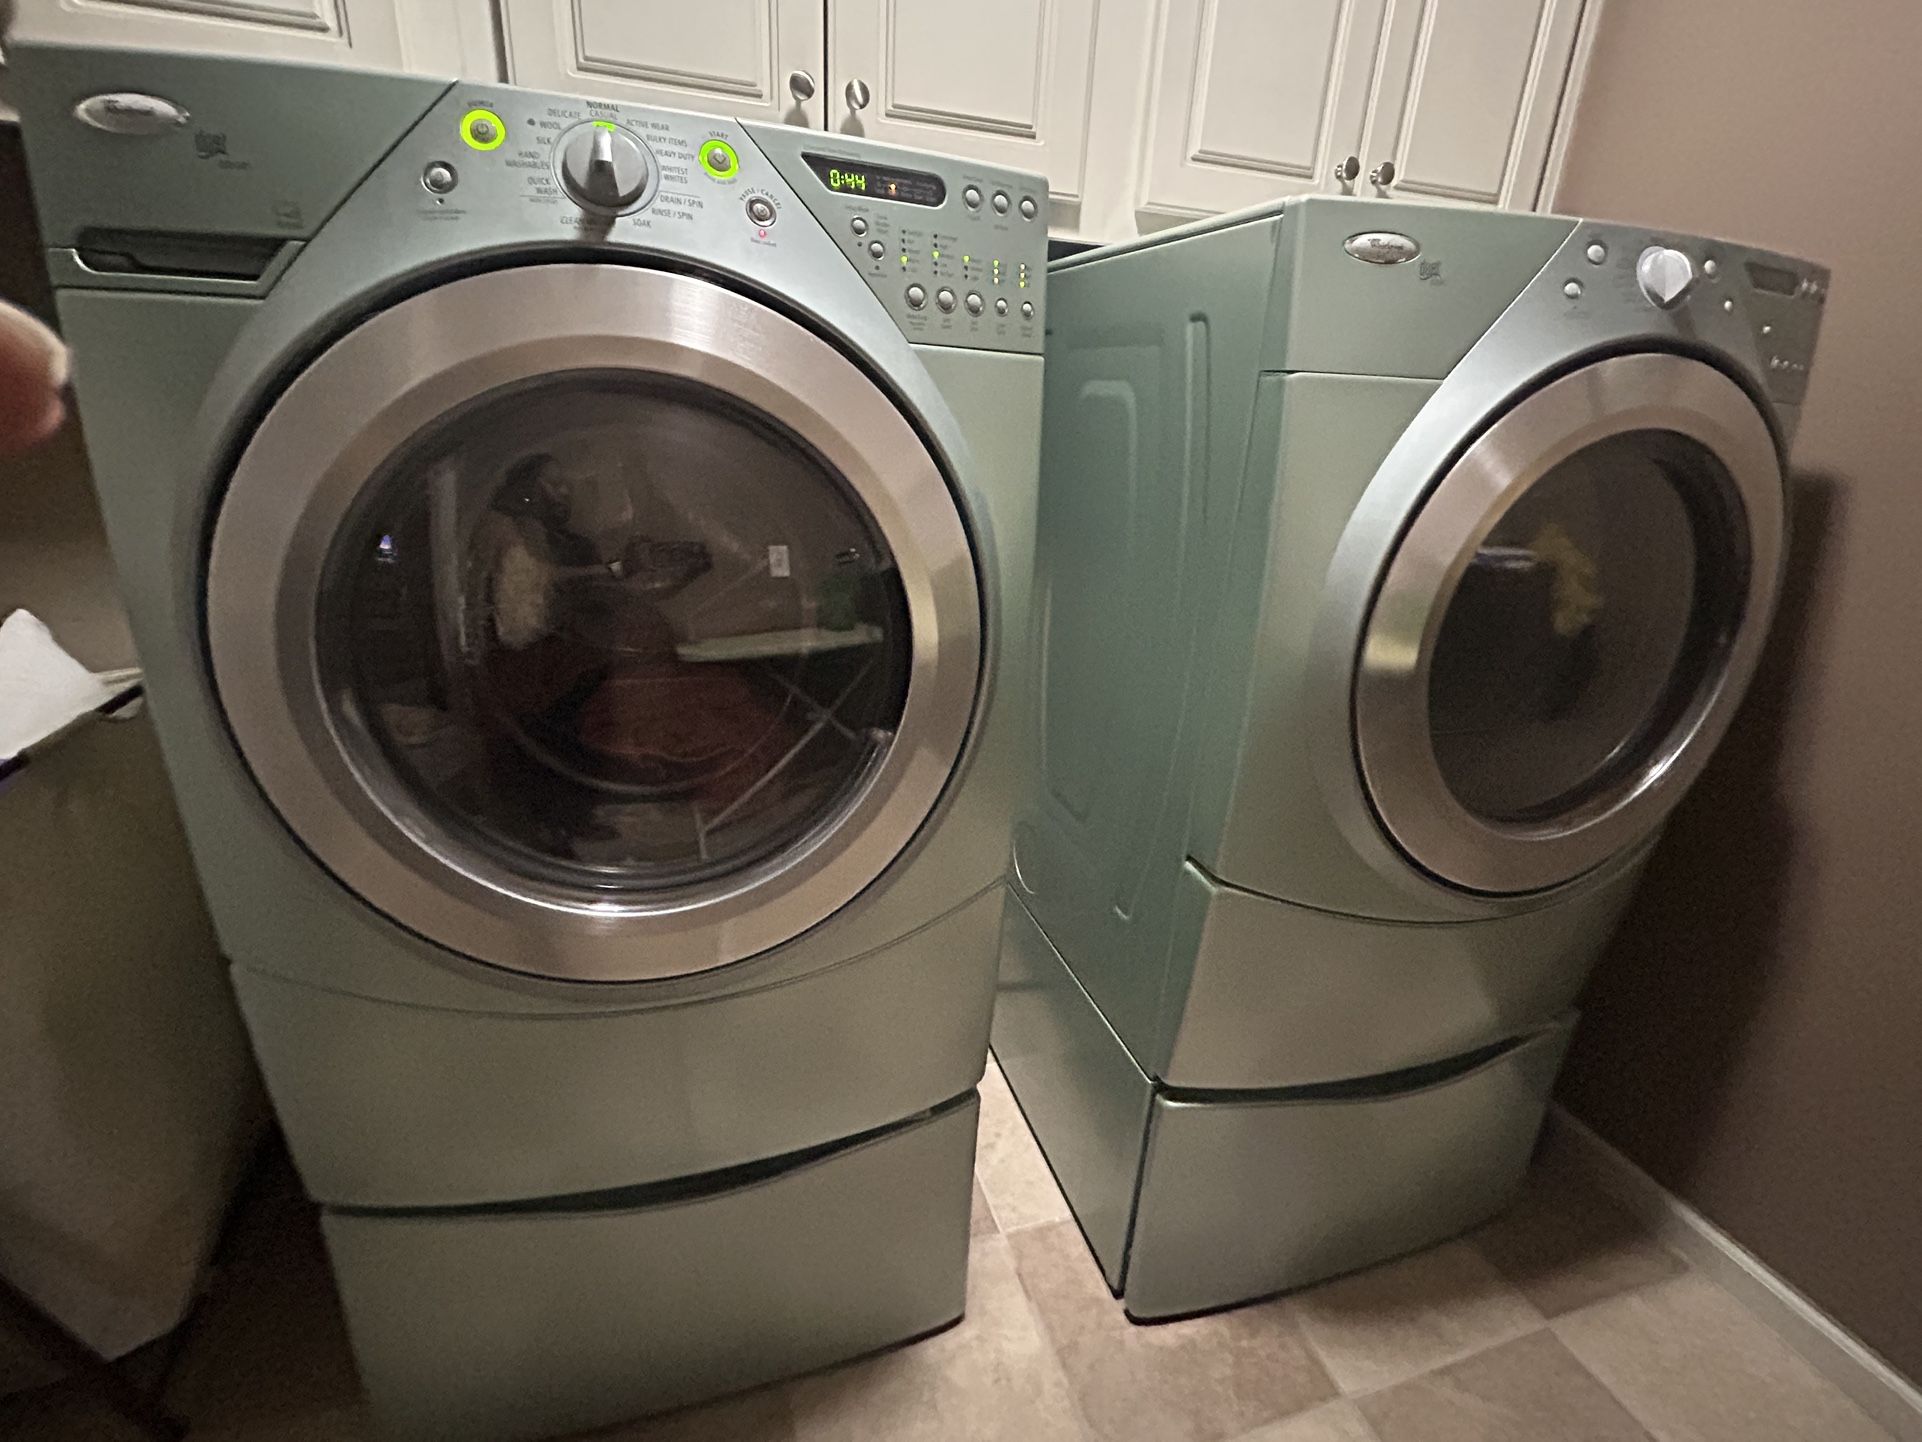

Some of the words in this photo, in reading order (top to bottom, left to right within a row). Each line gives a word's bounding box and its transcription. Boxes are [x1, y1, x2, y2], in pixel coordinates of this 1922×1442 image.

[586, 101, 620, 112] NORMAL
[547, 108, 581, 119] DELICATE
[589, 110, 618, 121] CASUAL
[540, 121, 561, 130] WOOL
[626, 119, 649, 129] ACTIVE
[651, 123, 670, 131] WEAR
[536, 136, 552, 145] SILK
[646, 134, 666, 144] BULKY
[668, 136, 688, 147] ITEMS
[708, 130, 729, 140] START
[656, 149, 677, 158] HEAVY
[677, 151, 695, 161] DUTY
[661, 165, 688, 175] WHITEST
[527, 176, 550, 186] QUICK
[664, 174, 688, 184] WHITES
[829, 169, 866, 191] 0:44
[535, 186, 558, 195] WASH
[660, 194, 682, 205] DRAIN
[687, 199, 704, 209] SPIN
[651, 207, 671, 218] RINSE
[676, 211, 694, 221] SPIN
[632, 218, 651, 228] SOAK
